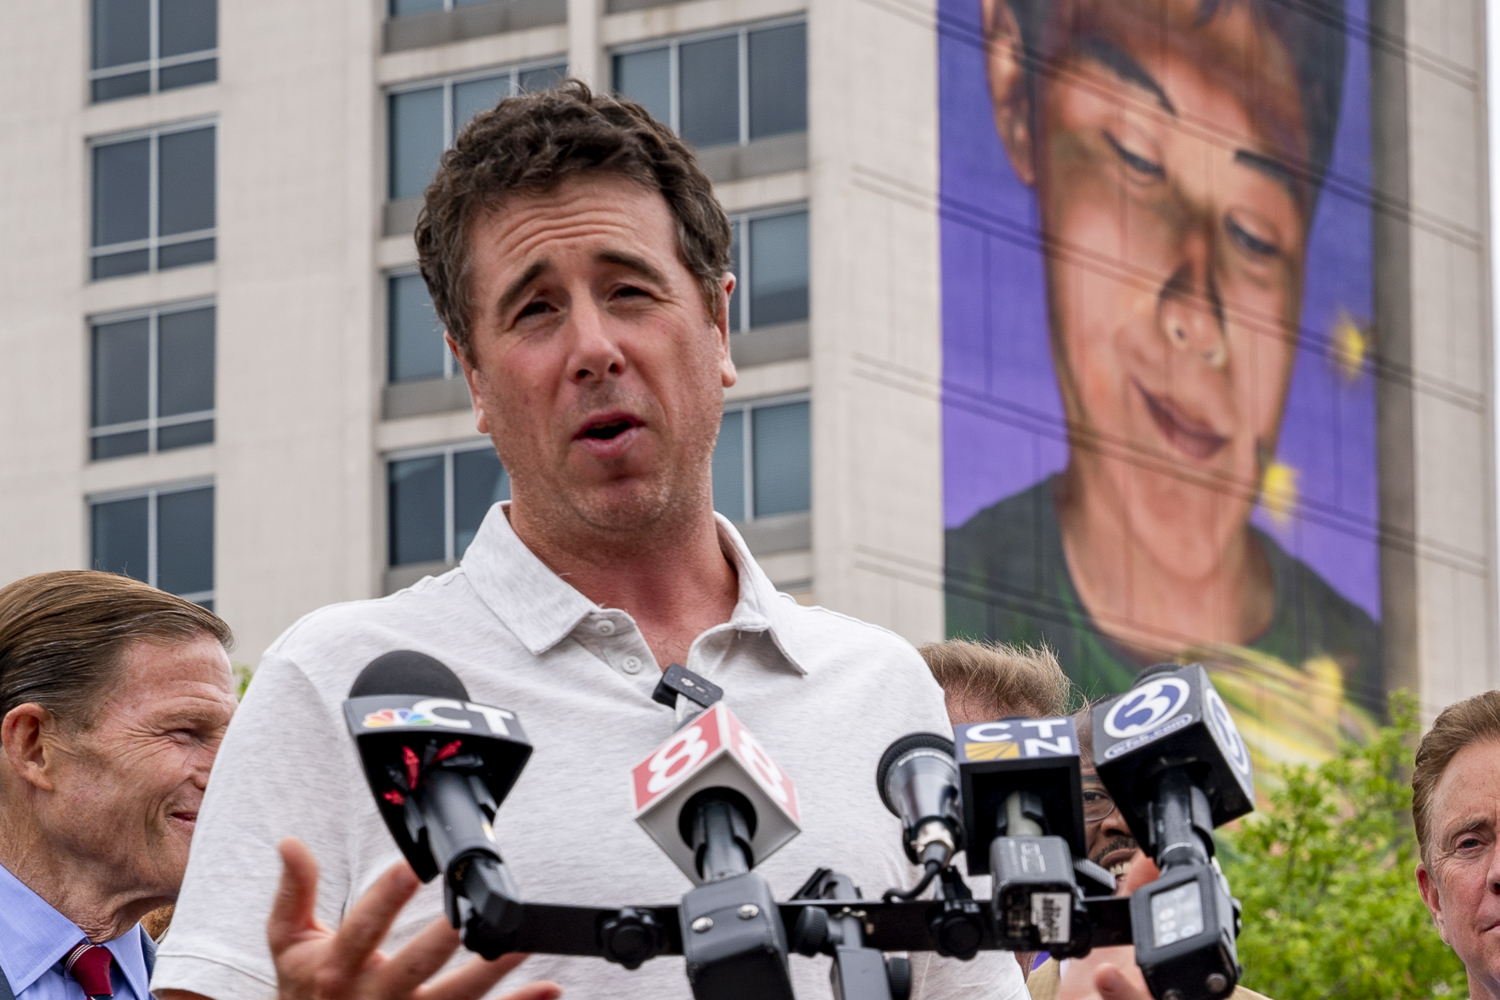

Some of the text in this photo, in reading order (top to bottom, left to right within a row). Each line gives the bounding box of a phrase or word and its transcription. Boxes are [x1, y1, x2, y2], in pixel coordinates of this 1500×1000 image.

[412, 699, 515, 736] CT
[1105, 678, 1189, 737] 3
[647, 725, 708, 794] 8
[739, 729, 789, 803] 8
